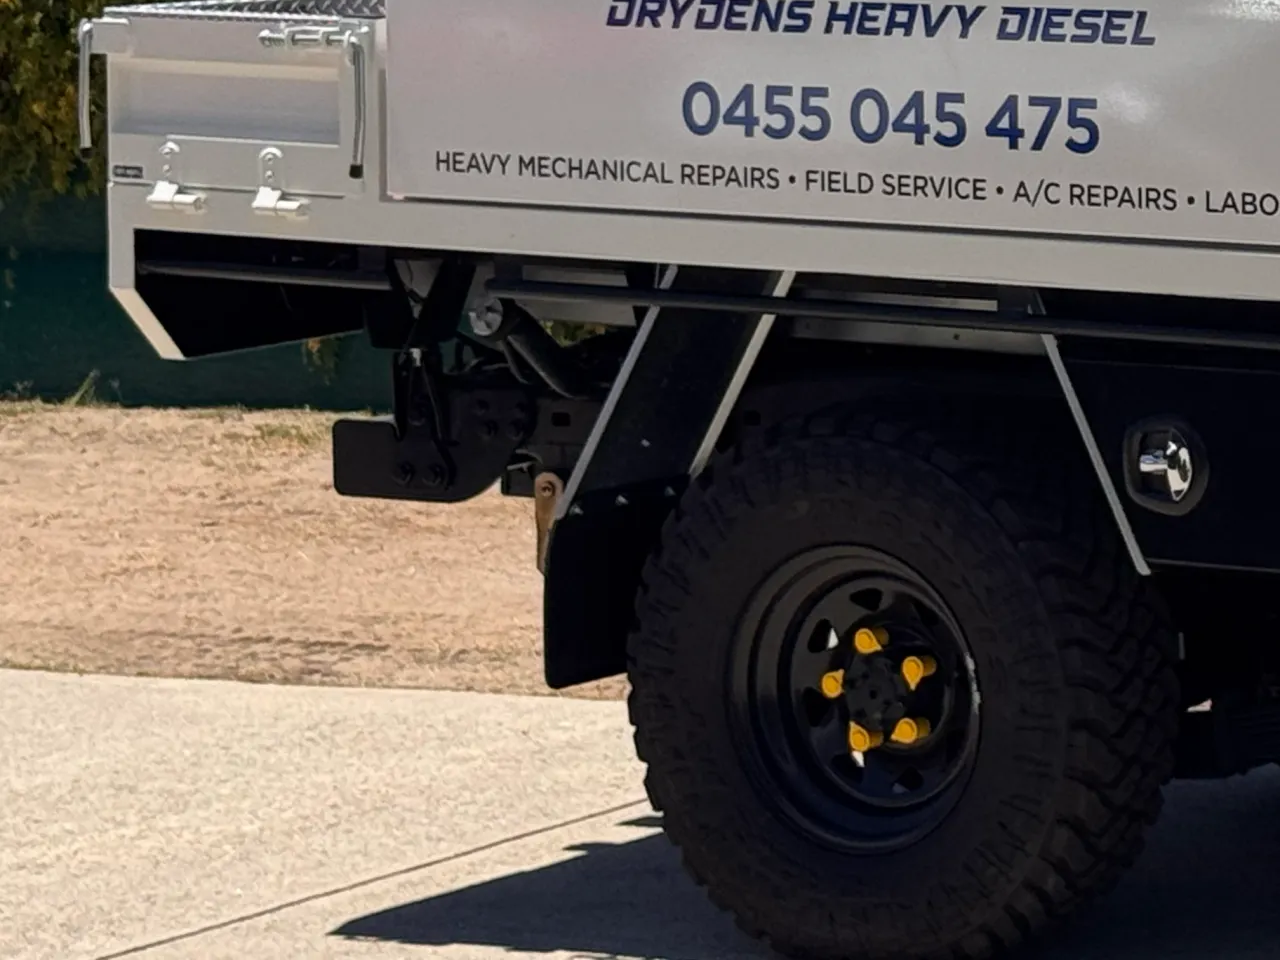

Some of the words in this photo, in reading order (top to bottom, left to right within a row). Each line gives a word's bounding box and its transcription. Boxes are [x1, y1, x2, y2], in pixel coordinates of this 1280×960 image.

[823, 0, 988, 40] HEAVY
[996, 5, 1156, 46] DIESEL
[682, 81, 831, 142] 0455
[849, 87, 967, 149] 045
[984, 94, 1100, 155] 475
[435, 150, 512, 176] HEAVY
[518, 154, 674, 185] MECHANICAL
[680, 163, 780, 190] REPAIRS
[805, 169, 875, 195] FIELD
[881, 173, 988, 201] SERVICE
[1013, 178, 1061, 208] A/C
[1068, 183, 1178, 212] REPAIRS
